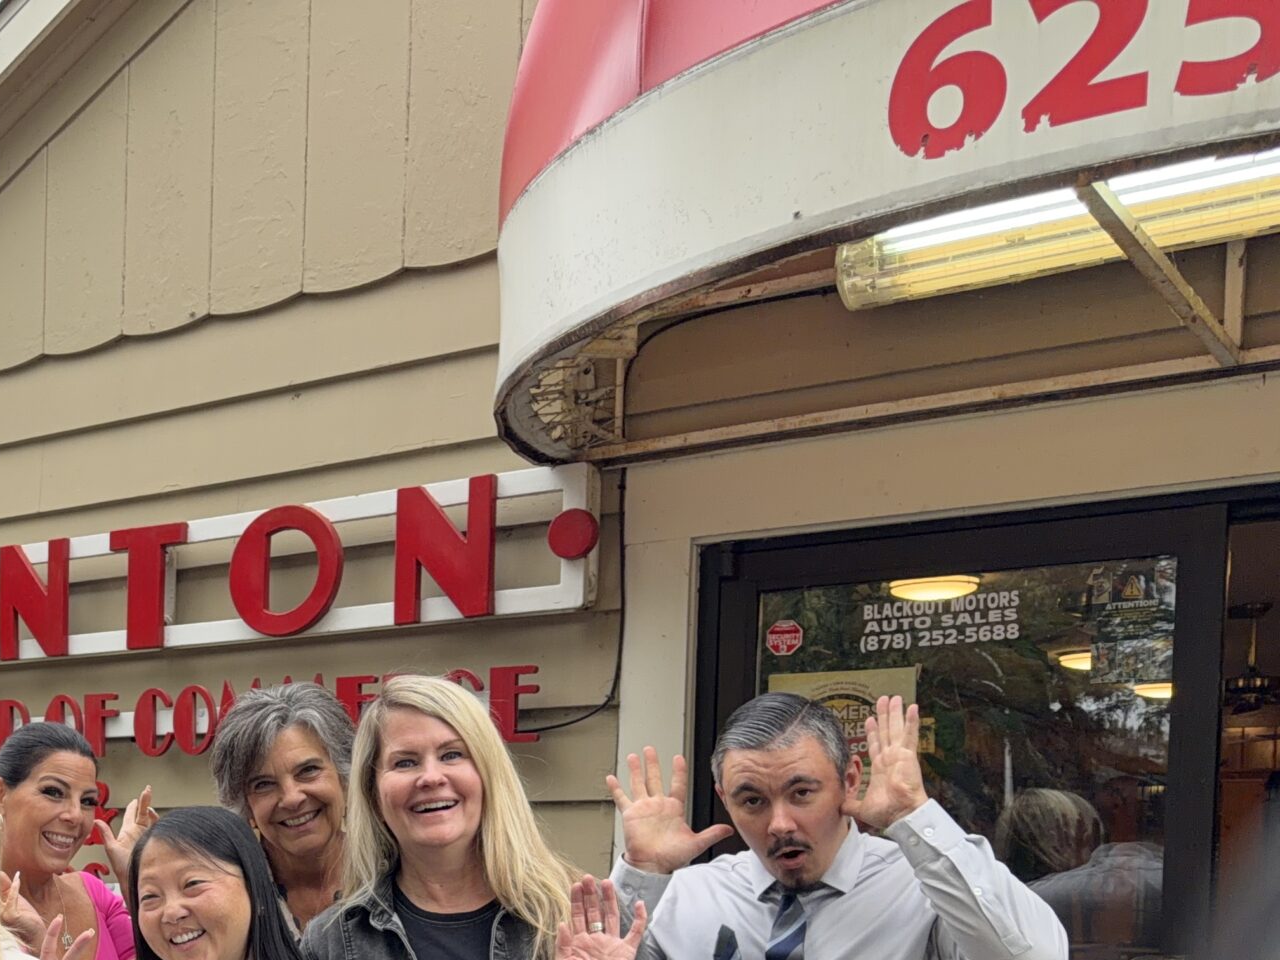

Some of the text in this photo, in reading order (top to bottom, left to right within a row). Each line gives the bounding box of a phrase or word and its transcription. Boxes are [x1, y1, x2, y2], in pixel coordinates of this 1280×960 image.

[863, 590, 1020, 620] BLACKOUT MOTORS
[863, 608, 1018, 634] AUTO SALES
[859, 623, 1020, 654] (878) 252-5688
[44, 693, 119, 758] OF
